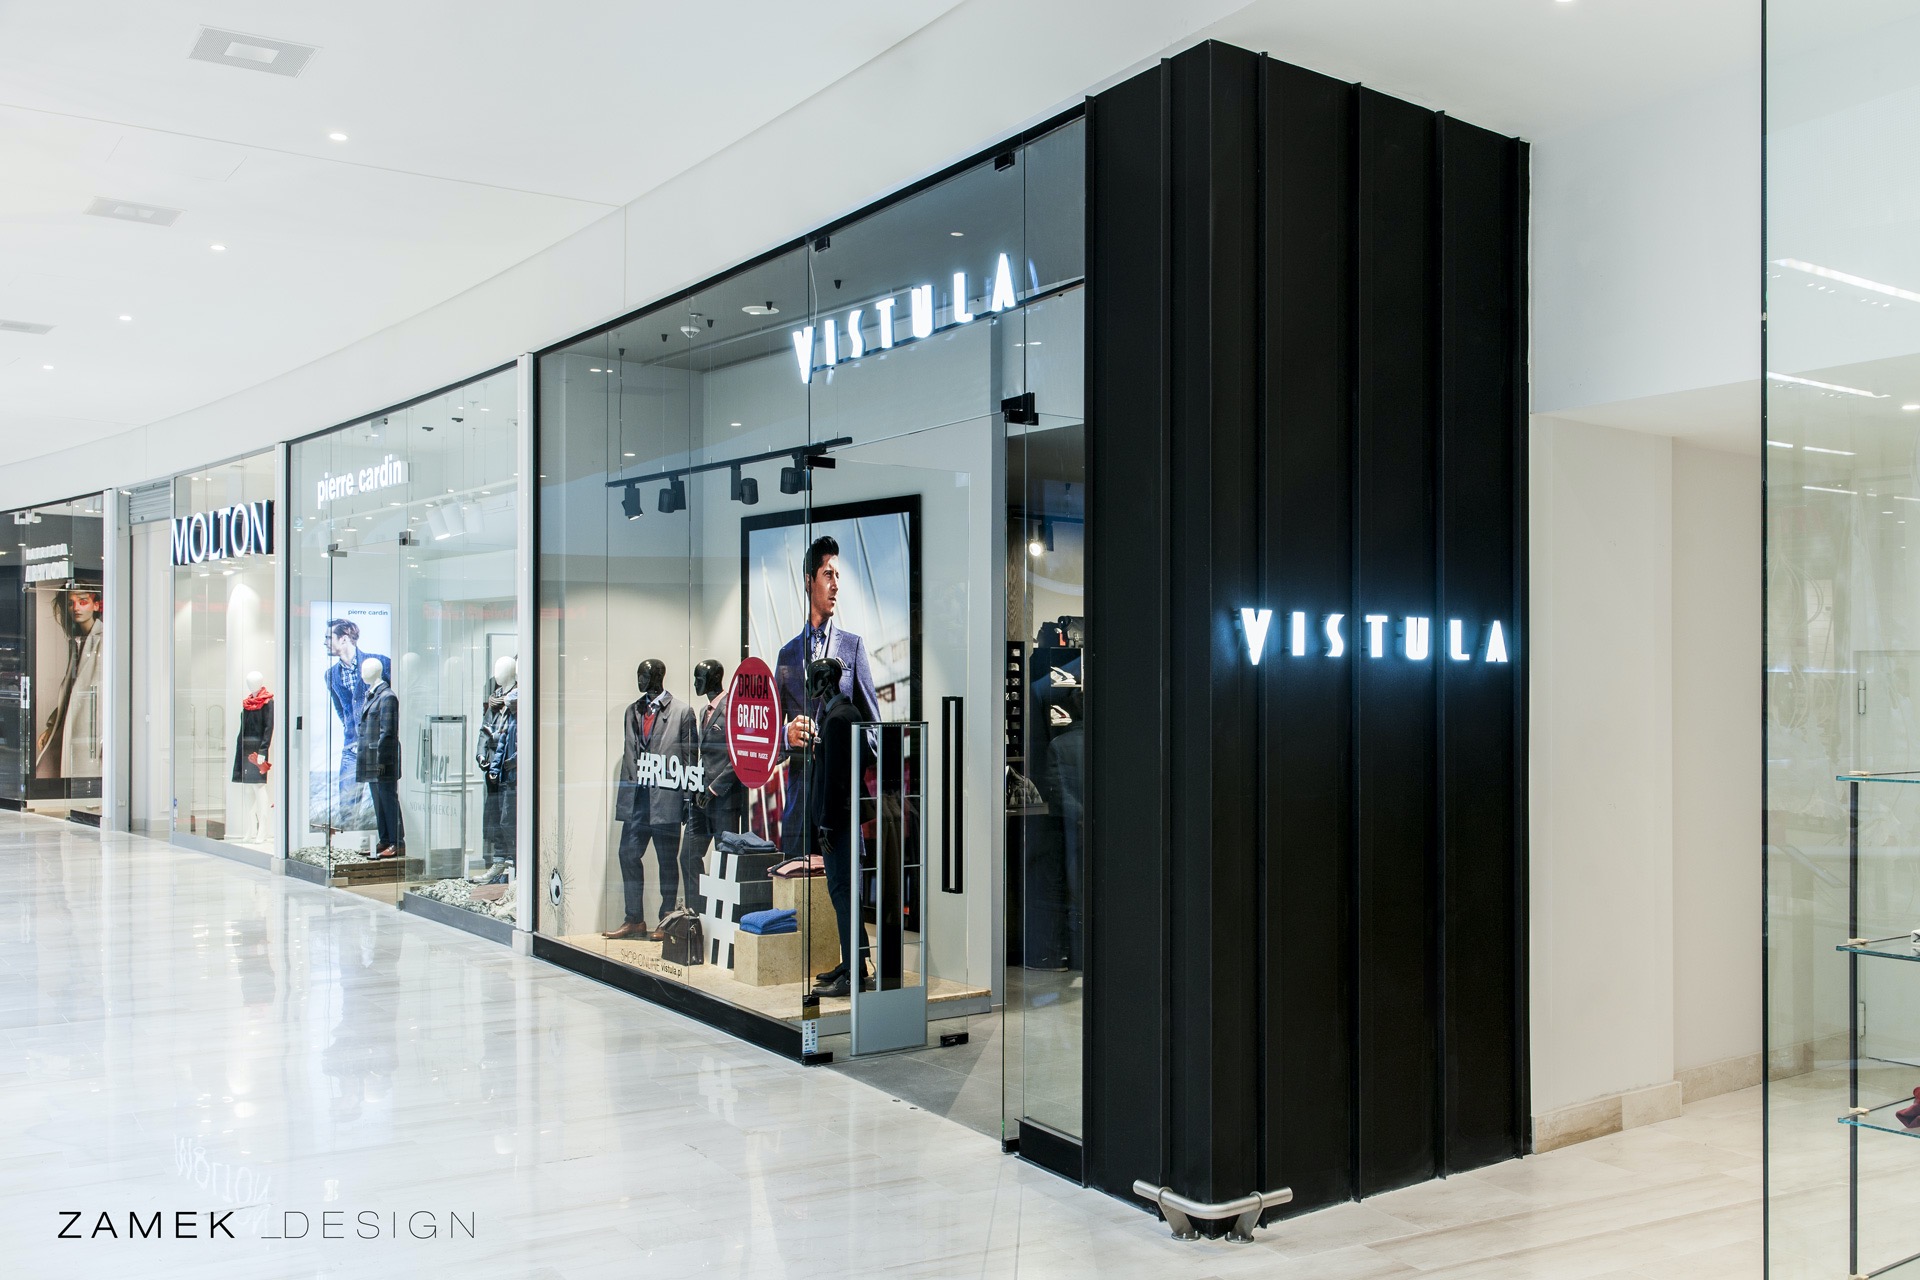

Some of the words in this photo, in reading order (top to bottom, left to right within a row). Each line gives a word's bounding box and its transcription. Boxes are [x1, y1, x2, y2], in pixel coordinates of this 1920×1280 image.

[792, 252, 1017, 384] VISTULA
[317, 471, 354, 510] pierre
[358, 453, 402, 493] cardin
[169, 499, 271, 567] MOLTON
[1240, 606, 1509, 666] VISTULA
[737, 673, 769, 699] DRUGA
